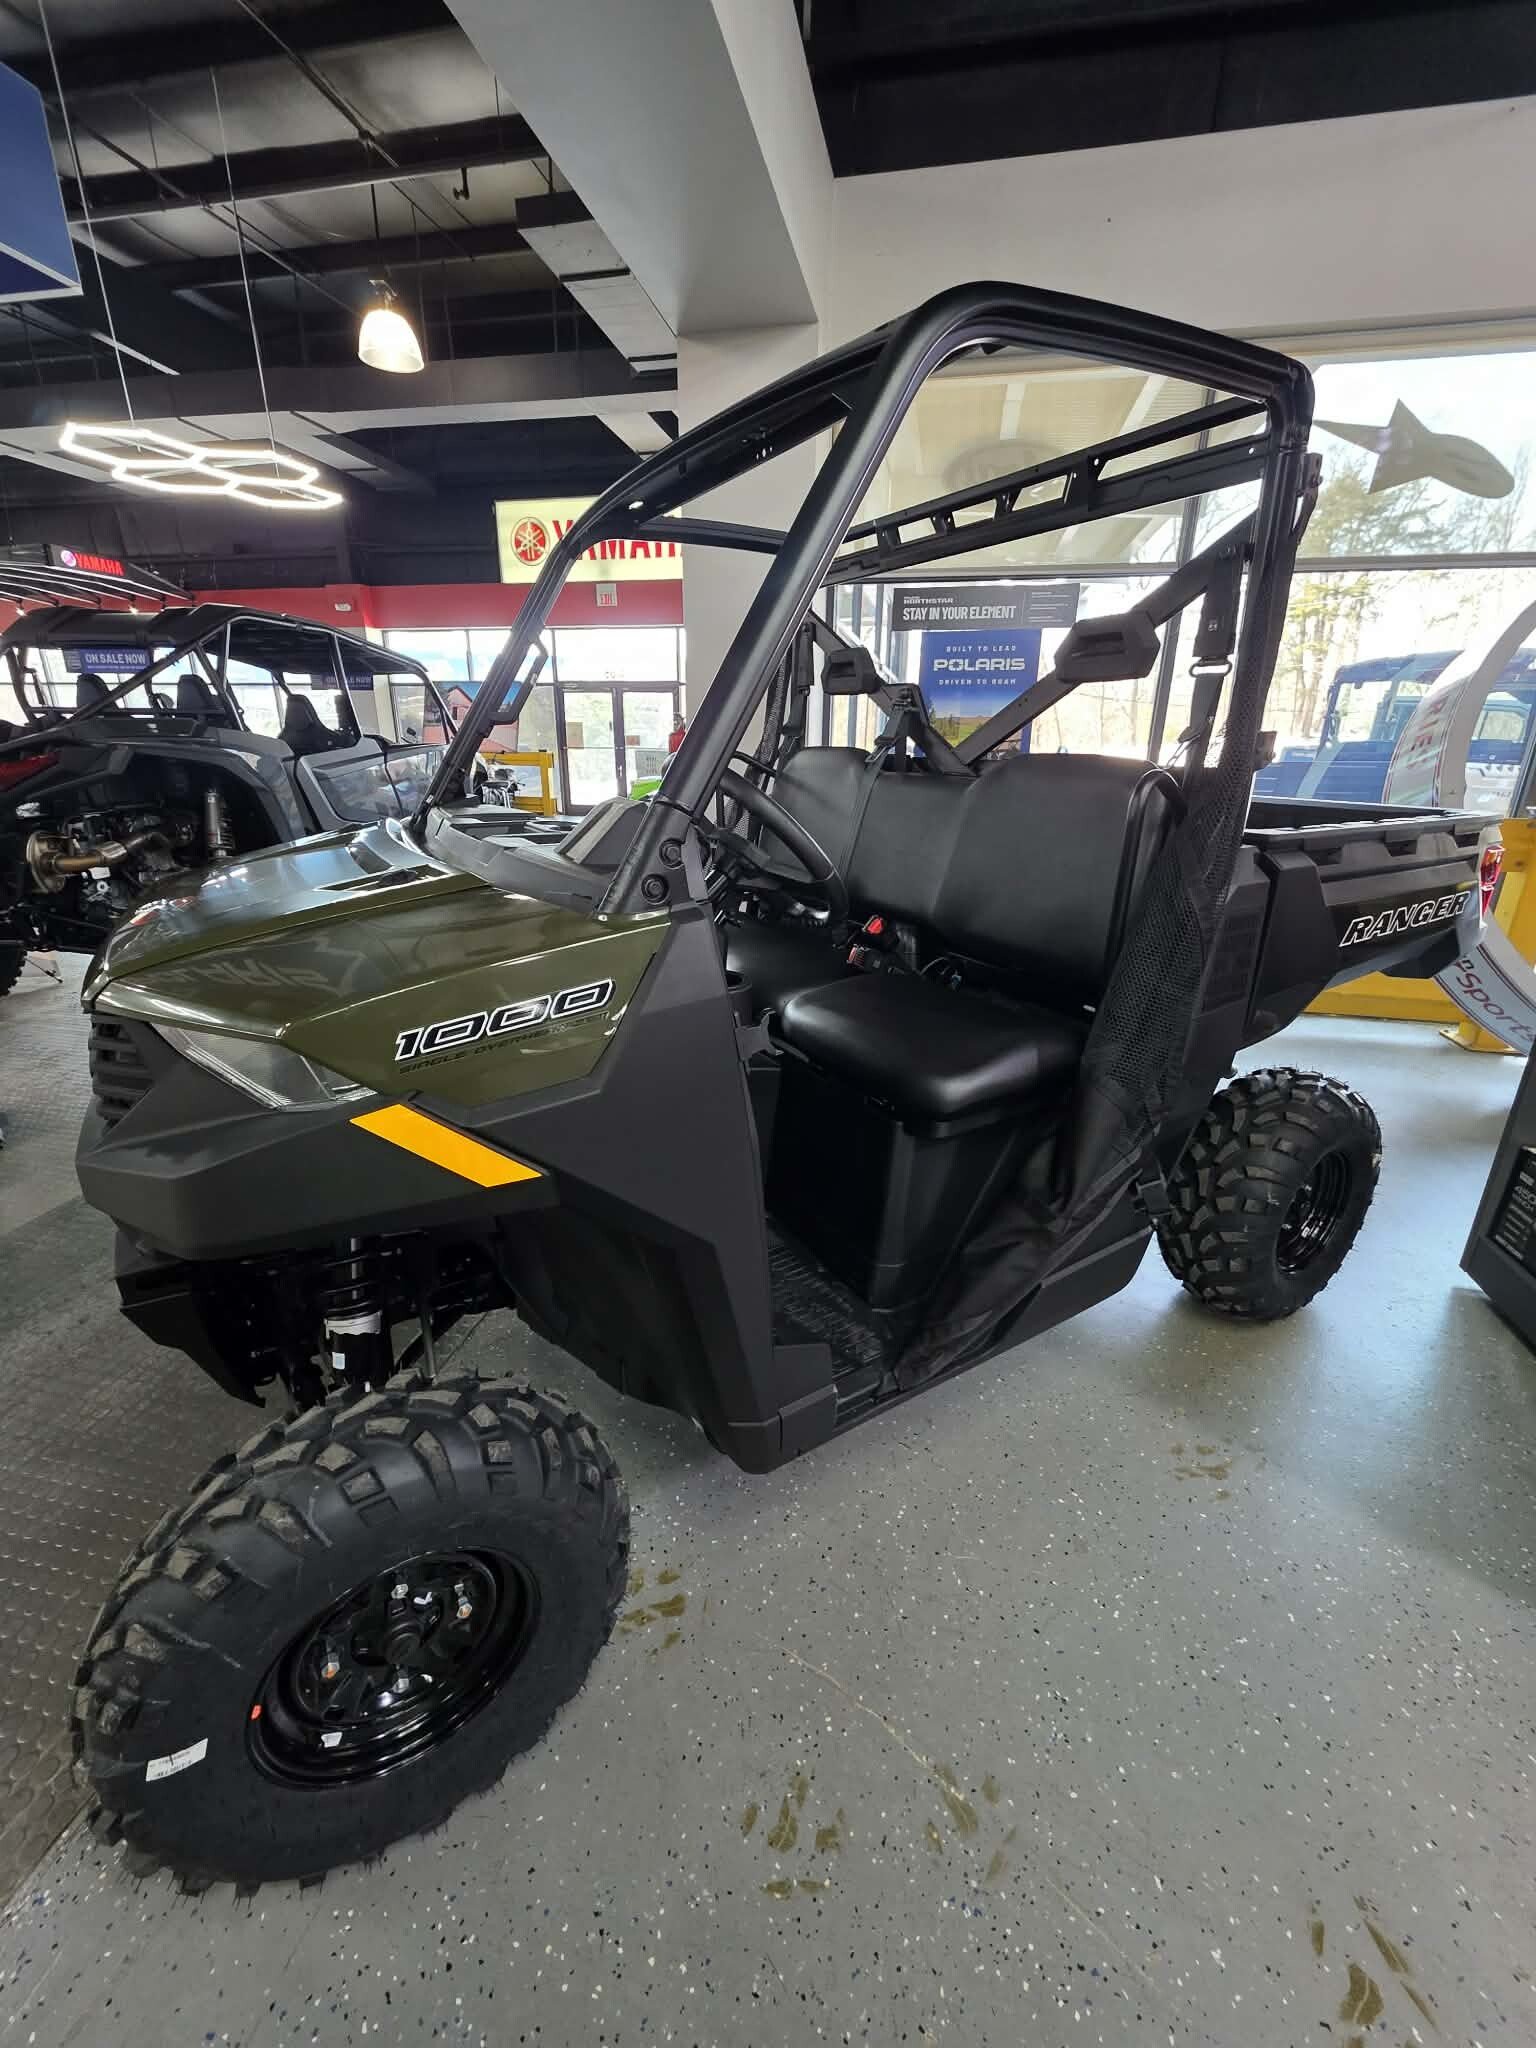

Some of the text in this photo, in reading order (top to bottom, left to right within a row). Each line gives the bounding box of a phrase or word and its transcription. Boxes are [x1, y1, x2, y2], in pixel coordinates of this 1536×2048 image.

[74, 553, 124, 576] YAMAHA
[902, 606, 928, 621] STAY
[929, 606, 941, 620] IN
[942, 605, 969, 620] YOUR
[969, 605, 1016, 619] ELEMENT
[946, 645, 973, 653] BUILT
[992, 644, 1017, 652] LEAD
[85, 653, 99, 664] ON
[100, 653, 124, 664] SALE
[125, 653, 146, 665] NOW
[933, 657, 1025, 671] POLARIS
[1339, 890, 1471, 947] RANGER
[395, 978, 617, 1061] 1000
